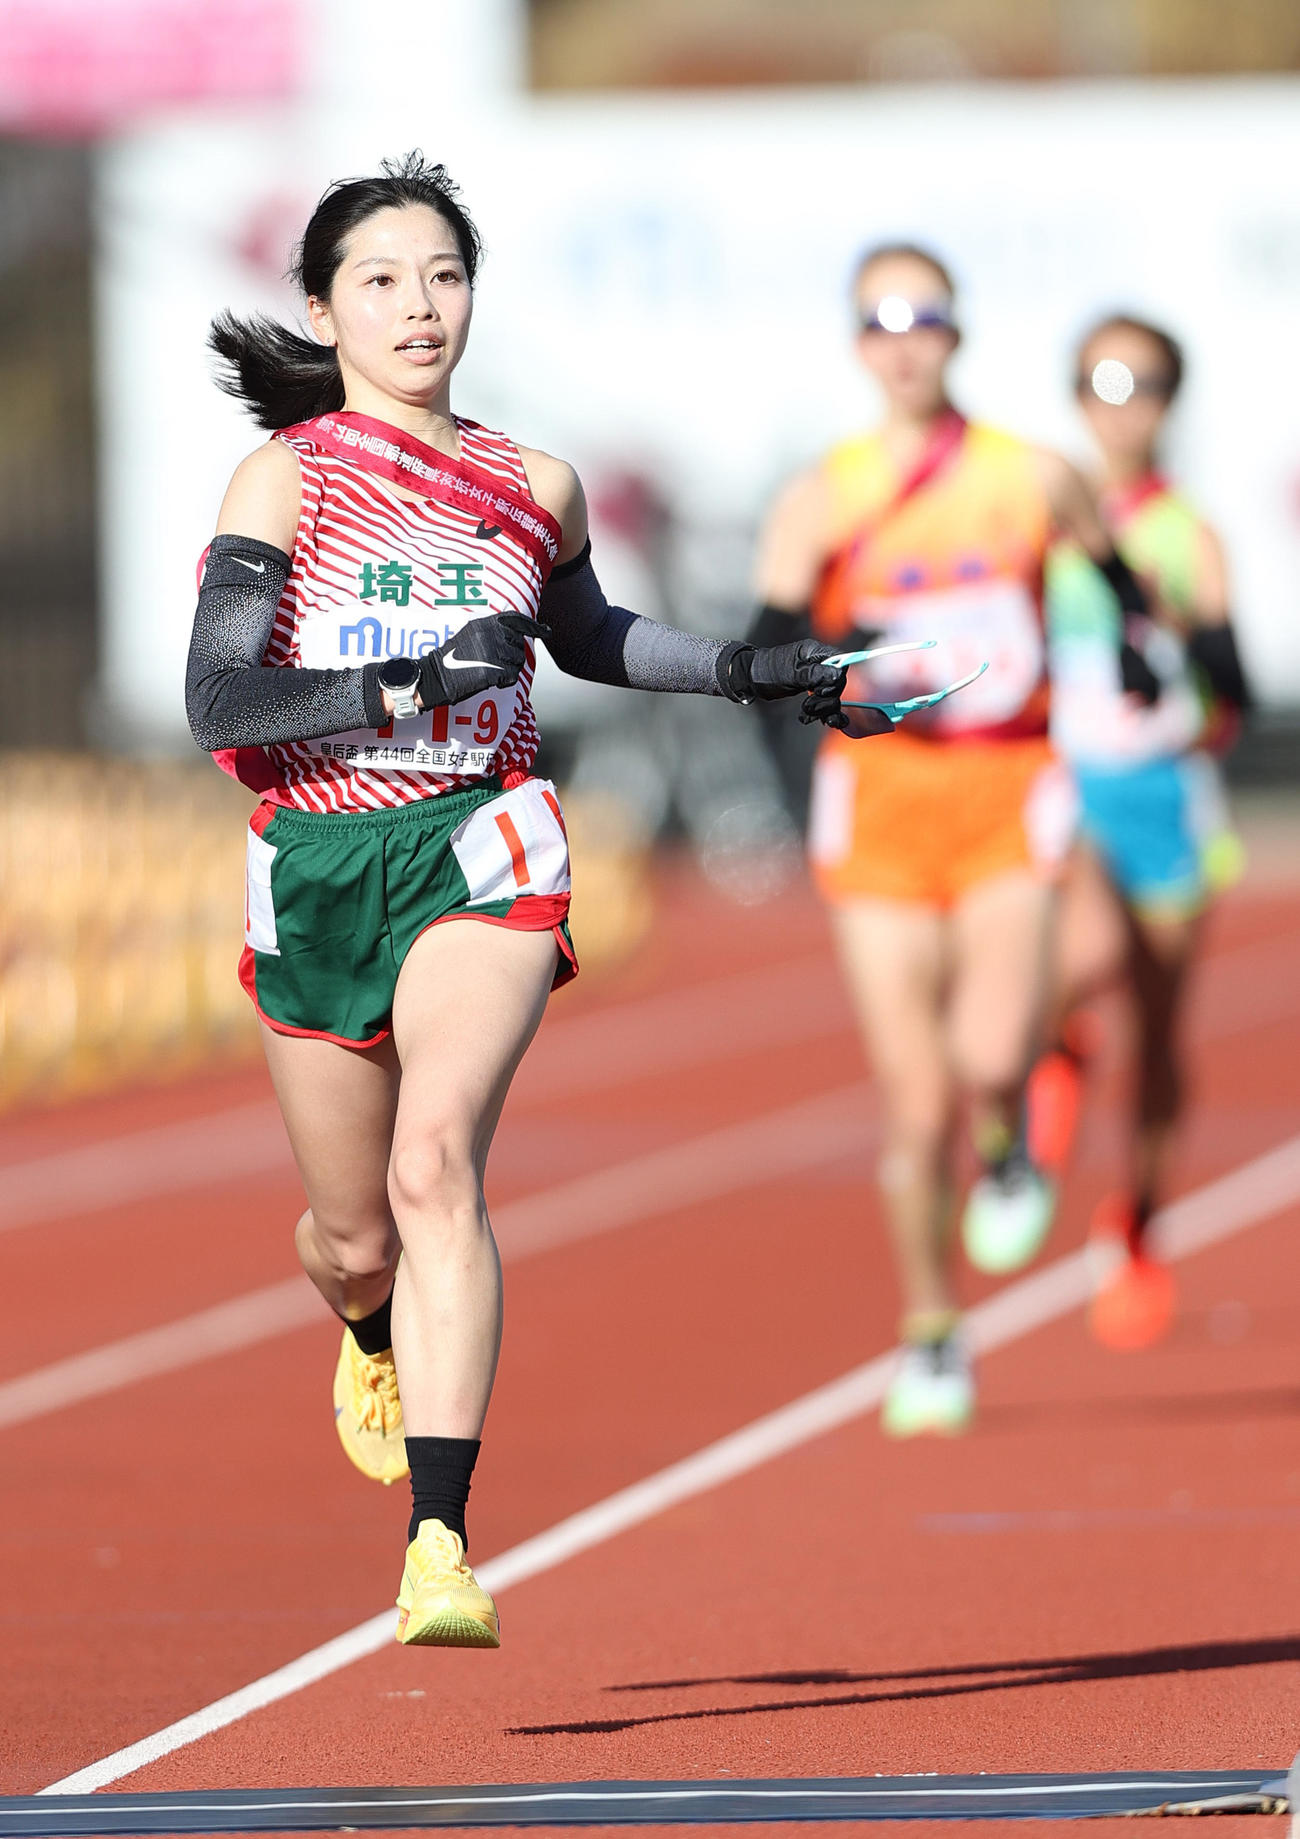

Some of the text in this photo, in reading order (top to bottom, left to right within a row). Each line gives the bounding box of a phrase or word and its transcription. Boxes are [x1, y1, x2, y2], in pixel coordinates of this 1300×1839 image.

[358, 561, 488, 607] 埼玉
[377, 699, 499, 745] 1-9
[320, 742, 359, 760] 皇后盃
